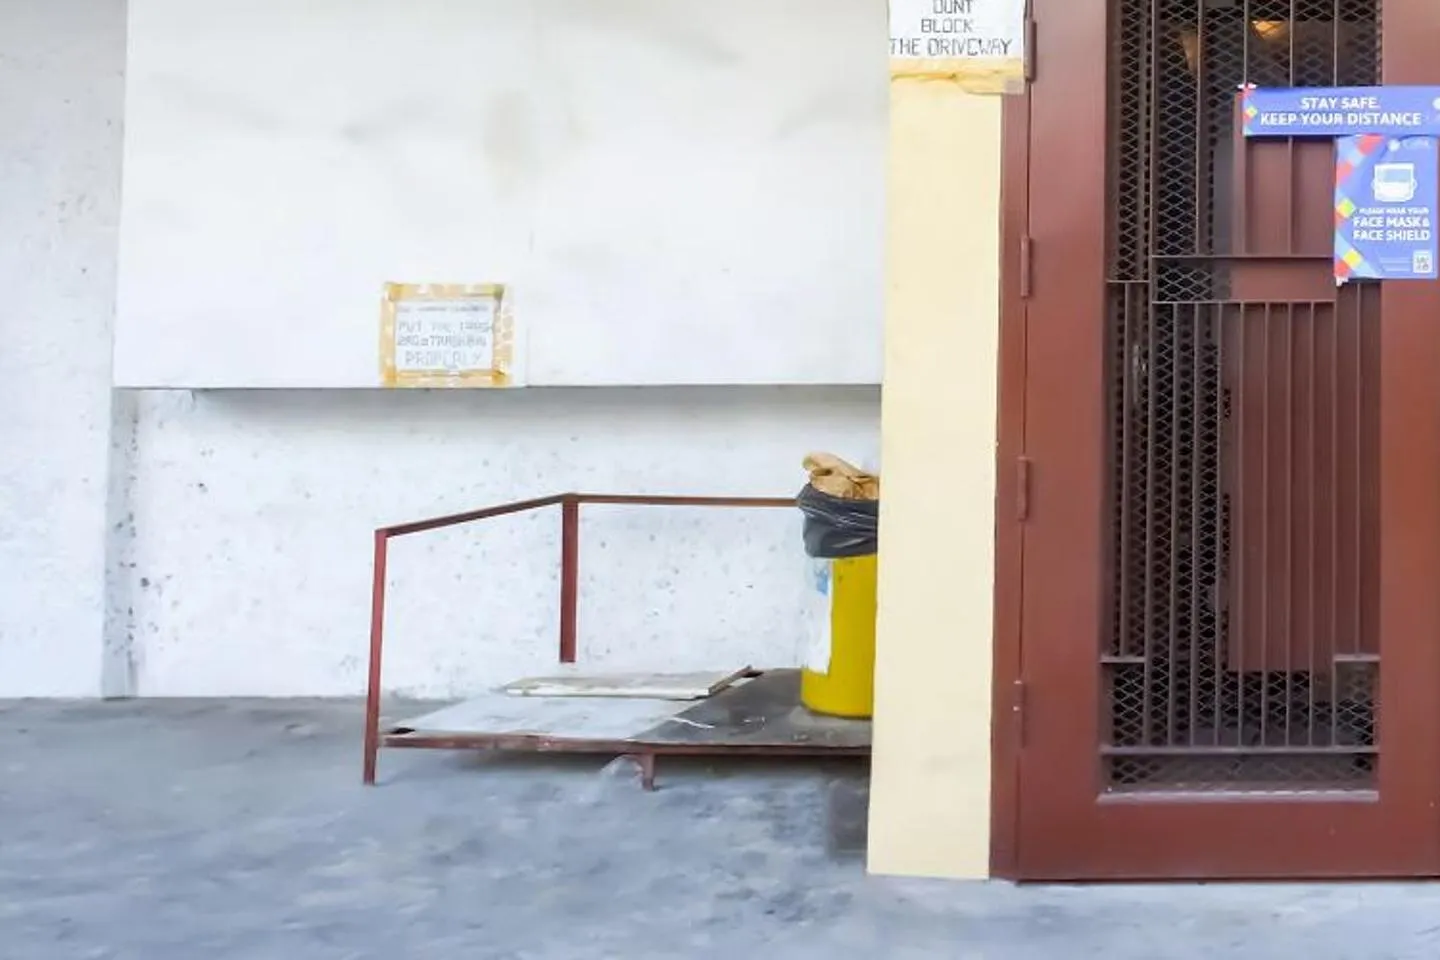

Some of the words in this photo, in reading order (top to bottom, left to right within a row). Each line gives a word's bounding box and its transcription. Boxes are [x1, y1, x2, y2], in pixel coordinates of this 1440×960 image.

[920, 18, 975, 34] BLOCK
[889, 38, 921, 55] THE
[1300, 97, 1338, 110] STAY
[1260, 113, 1297, 126] KEEP
[1299, 113, 1344, 126] YOUR
[1347, 112, 1422, 126] DISTANCE
[1353, 216, 1385, 227] FACE
[1386, 216, 1421, 228] MASK
[1353, 229, 1385, 240] FACE
[1386, 229, 1431, 241] SHIELD
